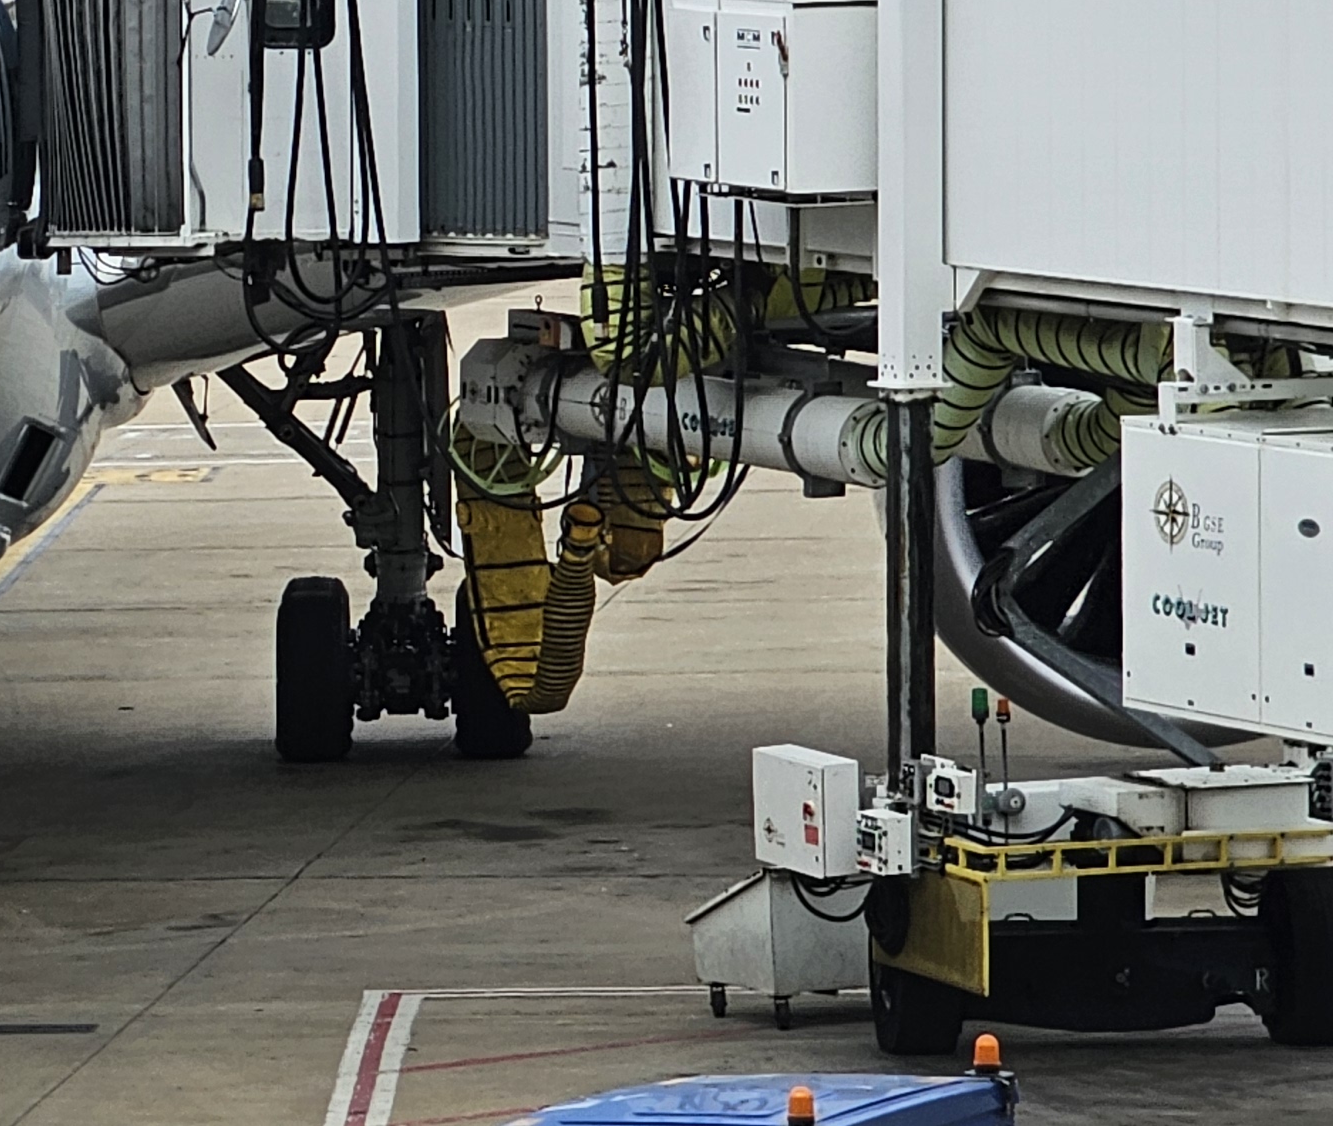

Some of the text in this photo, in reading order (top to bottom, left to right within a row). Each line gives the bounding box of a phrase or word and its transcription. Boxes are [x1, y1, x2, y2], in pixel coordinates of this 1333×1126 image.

[1191, 503, 1224, 533] B GSE
[1192, 532, 1224, 556] Group
